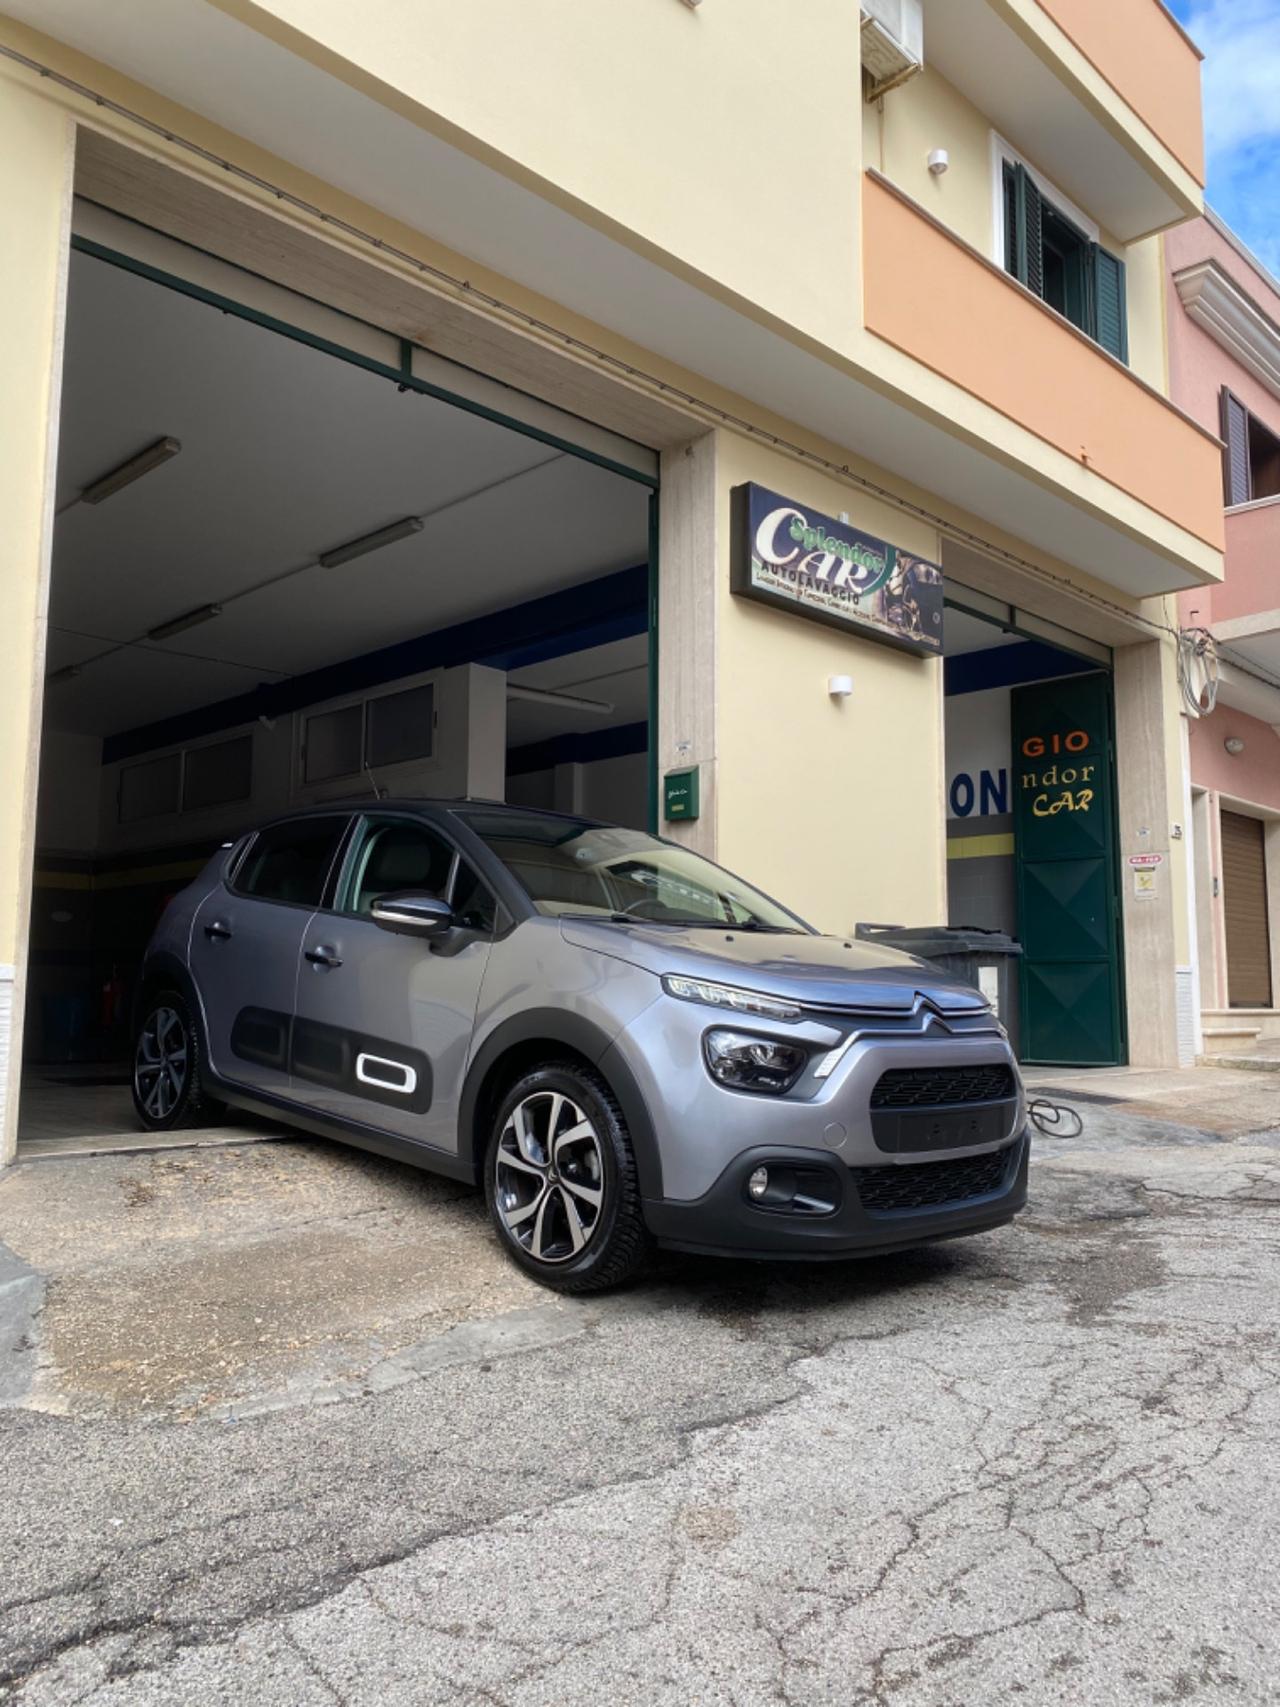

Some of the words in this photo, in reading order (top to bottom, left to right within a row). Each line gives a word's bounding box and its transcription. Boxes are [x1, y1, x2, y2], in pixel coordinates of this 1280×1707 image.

[756, 507, 868, 594] CAR
[788, 515, 884, 574] Splendor
[761, 561, 859, 605] AUTOLAVAGGIO
[1022, 730, 1089, 757] GIO
[950, 768, 1007, 817] ON
[1022, 765, 1095, 788] ndor
[1032, 788, 1093, 817] CAR
